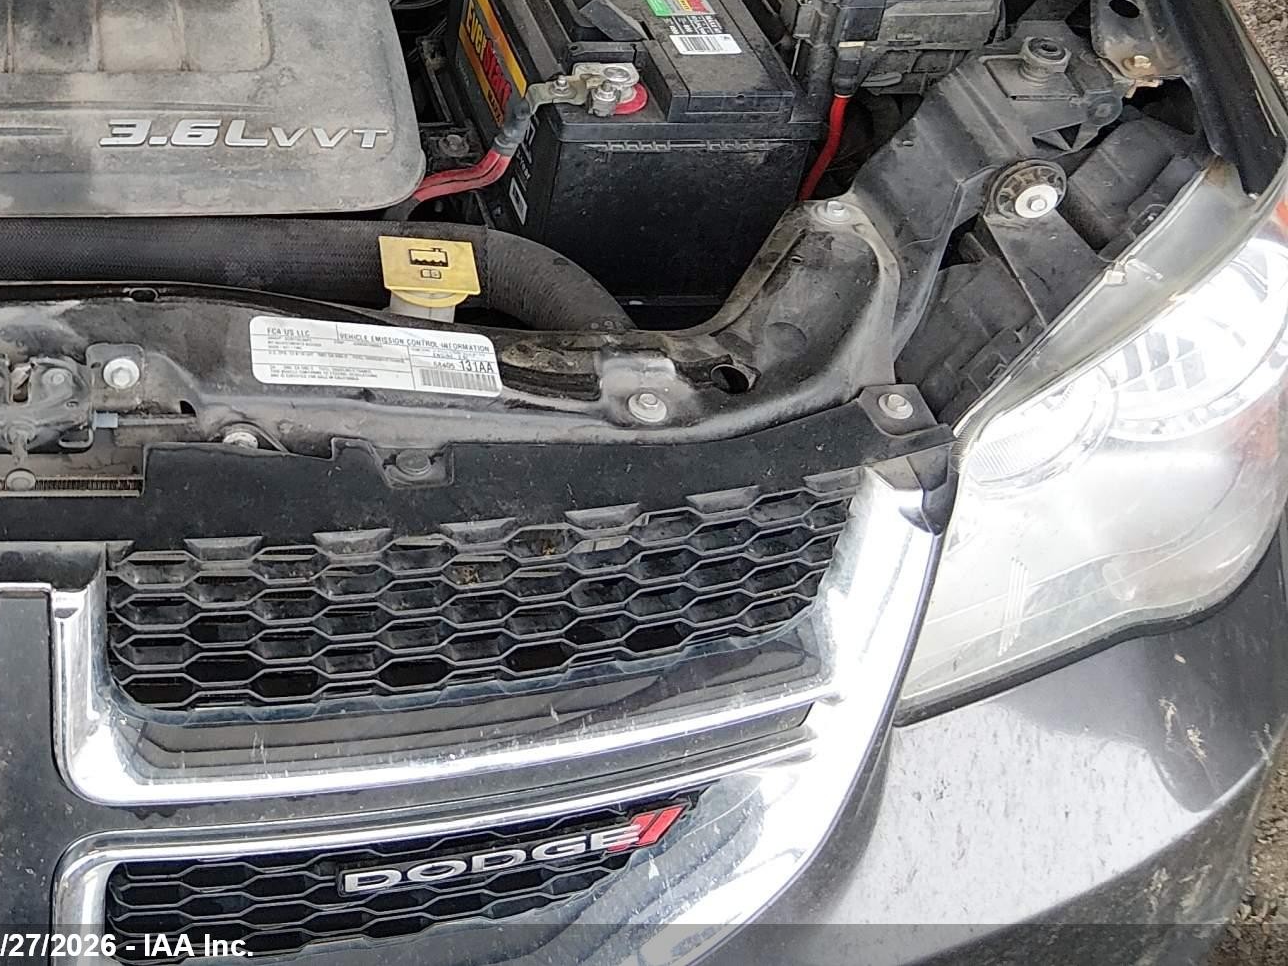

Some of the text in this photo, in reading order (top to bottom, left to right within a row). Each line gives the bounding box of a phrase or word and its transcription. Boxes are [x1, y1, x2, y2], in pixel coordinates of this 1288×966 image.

[339, 333, 368, 341] VEHICLE
[372, 335, 404, 345] EMISSION
[407, 339, 438, 348] CONTROL
[344, 824, 642, 893] DODGE
